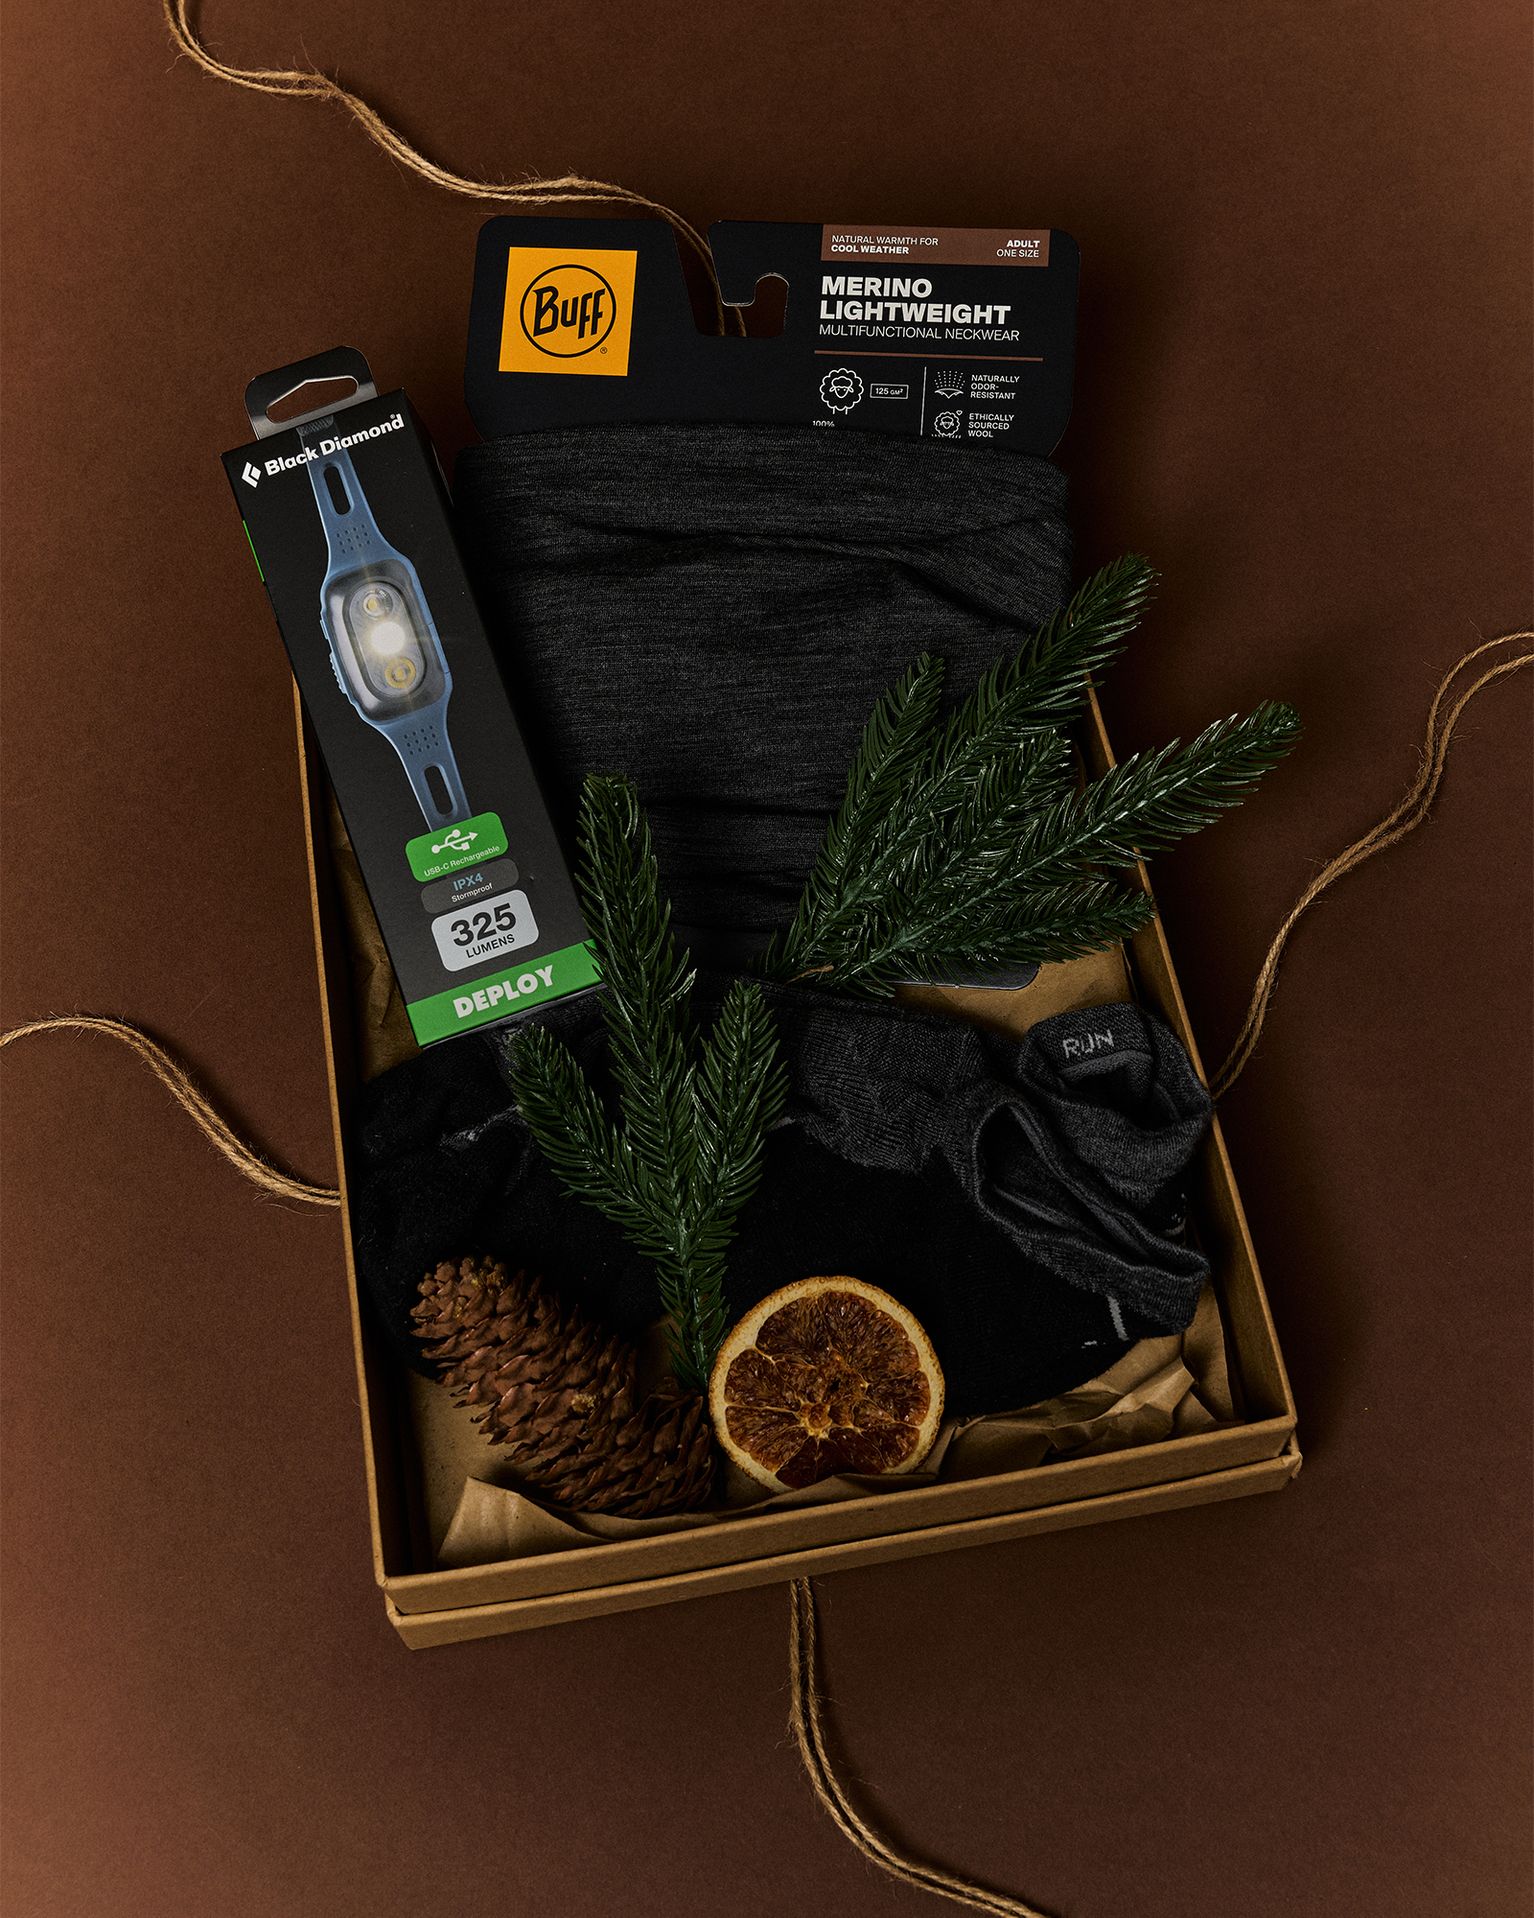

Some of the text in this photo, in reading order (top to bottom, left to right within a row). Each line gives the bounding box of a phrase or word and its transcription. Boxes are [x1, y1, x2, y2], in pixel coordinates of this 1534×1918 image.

[831, 234, 939, 246] NATURAL WARMTH FOR
[831, 244, 910, 255] COOL WEATHER
[1006, 239, 1041, 249] ADULT
[996, 248, 1040, 258] ONE SIZE
[821, 275, 933, 298] MERINO
[532, 285, 606, 340] Buff
[819, 300, 1012, 325] LIGHTWEIGHT
[819, 323, 1020, 342] MULTIFUNCTIONAL NECKWEAR
[970, 383, 999, 391] ODOR-
[971, 374, 1020, 383] NATURALLY
[875, 387, 889, 395] 125
[970, 391, 1016, 400] RESISTANT
[968, 413, 1015, 422] ETHICALLY
[968, 421, 1010, 430] SOURCED
[968, 429, 994, 438] WOOL
[264, 447, 320, 477] Black
[423, 845, 500, 877] USB-C Rechargeable
[452, 872, 484, 892] IPX4
[451, 882, 493, 903] Stormproof
[450, 902, 517, 947] 325
[465, 933, 516, 959] LUMENS
[452, 964, 554, 1019] DEPLOY
[1062, 1029, 1114, 1059] RUN
